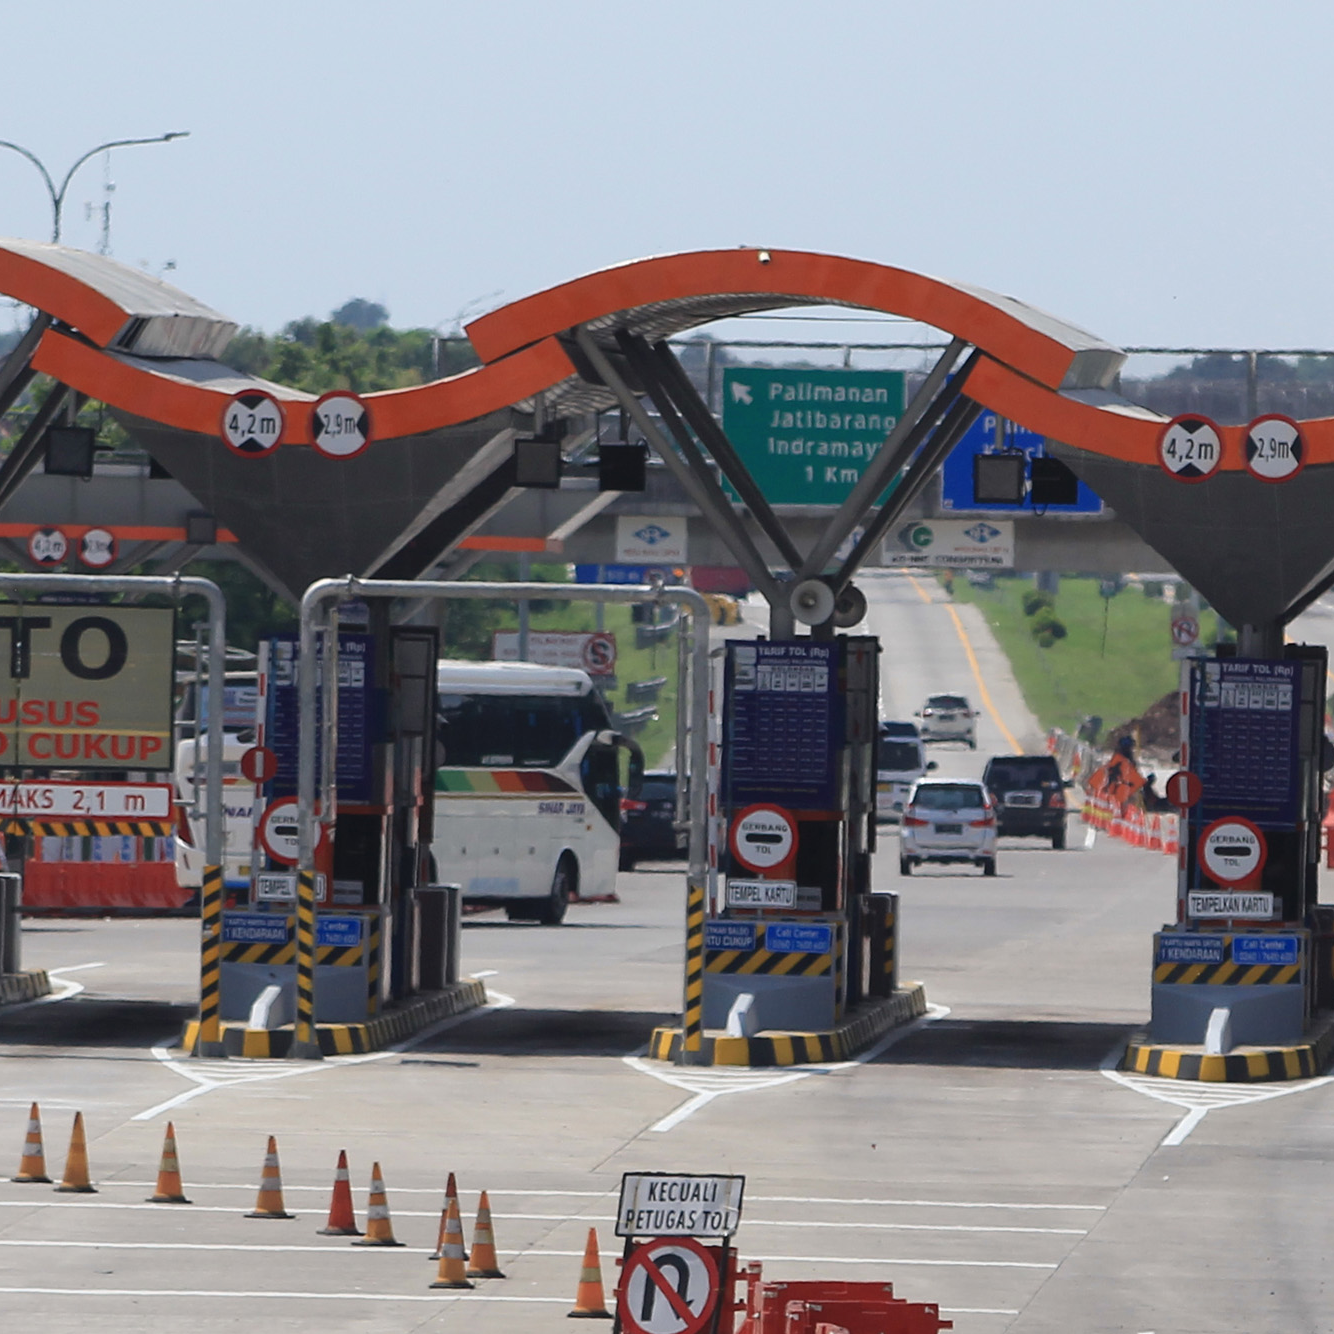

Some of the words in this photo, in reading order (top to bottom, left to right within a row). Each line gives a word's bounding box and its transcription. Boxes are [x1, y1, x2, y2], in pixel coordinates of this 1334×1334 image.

[770, 383, 887, 402] Palimanan
[771, 410, 896, 435] Jatibarang
[768, 438, 882, 462] Indramay
[806, 466, 813, 482] 1
[825, 467, 858, 482] Km
[789, 647, 807, 656] TOL
[1222, 664, 1250, 672] TARIF
[1252, 664, 1271, 674] TOL
[1274, 665, 1294, 676] (Rp)
[27, 732, 162, 760] CUKUP
[72, 790, 106, 814] 2,1
[124, 795, 145, 811] m
[742, 822, 788, 832] GERBANG
[1210, 835, 1256, 844] GERBANG
[756, 846, 772, 854] TOL
[1224, 858, 1240, 866] TOL
[730, 886, 761, 902] TEMPEL
[766, 886, 792, 903] KARTU
[1192, 898, 1240, 913] TEMPELKAN
[1242, 898, 1269, 914] KARTU
[648, 1182, 718, 1202] KECUALI
[626, 1210, 696, 1230] PETUGAS
[702, 1211, 730, 1230] TOL
